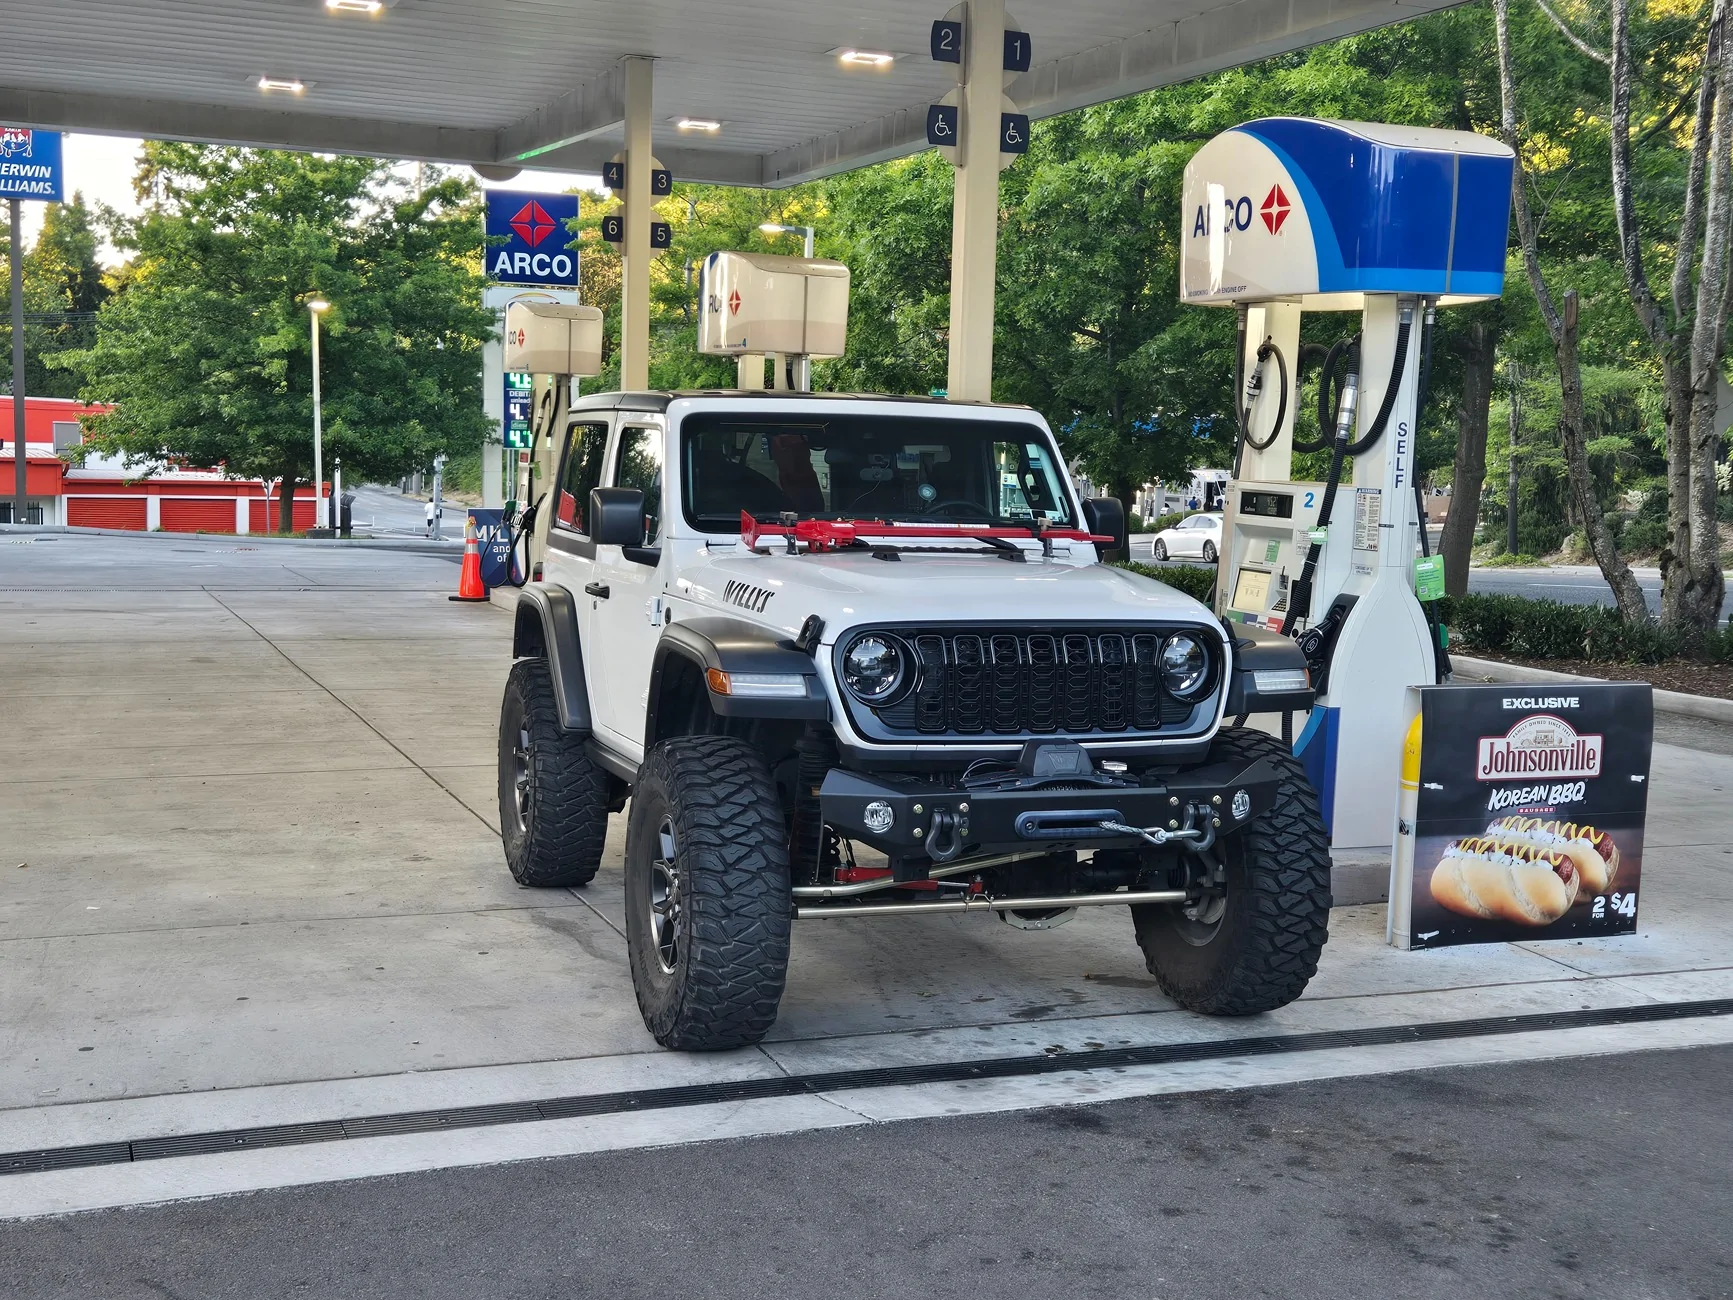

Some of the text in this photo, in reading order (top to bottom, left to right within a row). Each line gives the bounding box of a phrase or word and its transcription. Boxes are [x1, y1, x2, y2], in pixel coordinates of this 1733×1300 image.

[940, 28, 953, 50] 2
[1013, 40, 1021, 61] 1
[608, 167, 618, 181] 4
[657, 174, 667, 188] 3
[608, 220, 618, 235] 6
[656, 227, 667, 242] 5
[494, 251, 572, 278] ARCO
[1394, 421, 1409, 489] SELF
[1303, 492, 1315, 509] 2
[723, 579, 776, 613] WILLYS
[1502, 697, 1580, 709] EXCLUSIVE
[1482, 739, 1597, 775] Johnsonville
[1488, 781, 1587, 811] KOREAN BBQ
[1592, 892, 1637, 917] 2 $4
